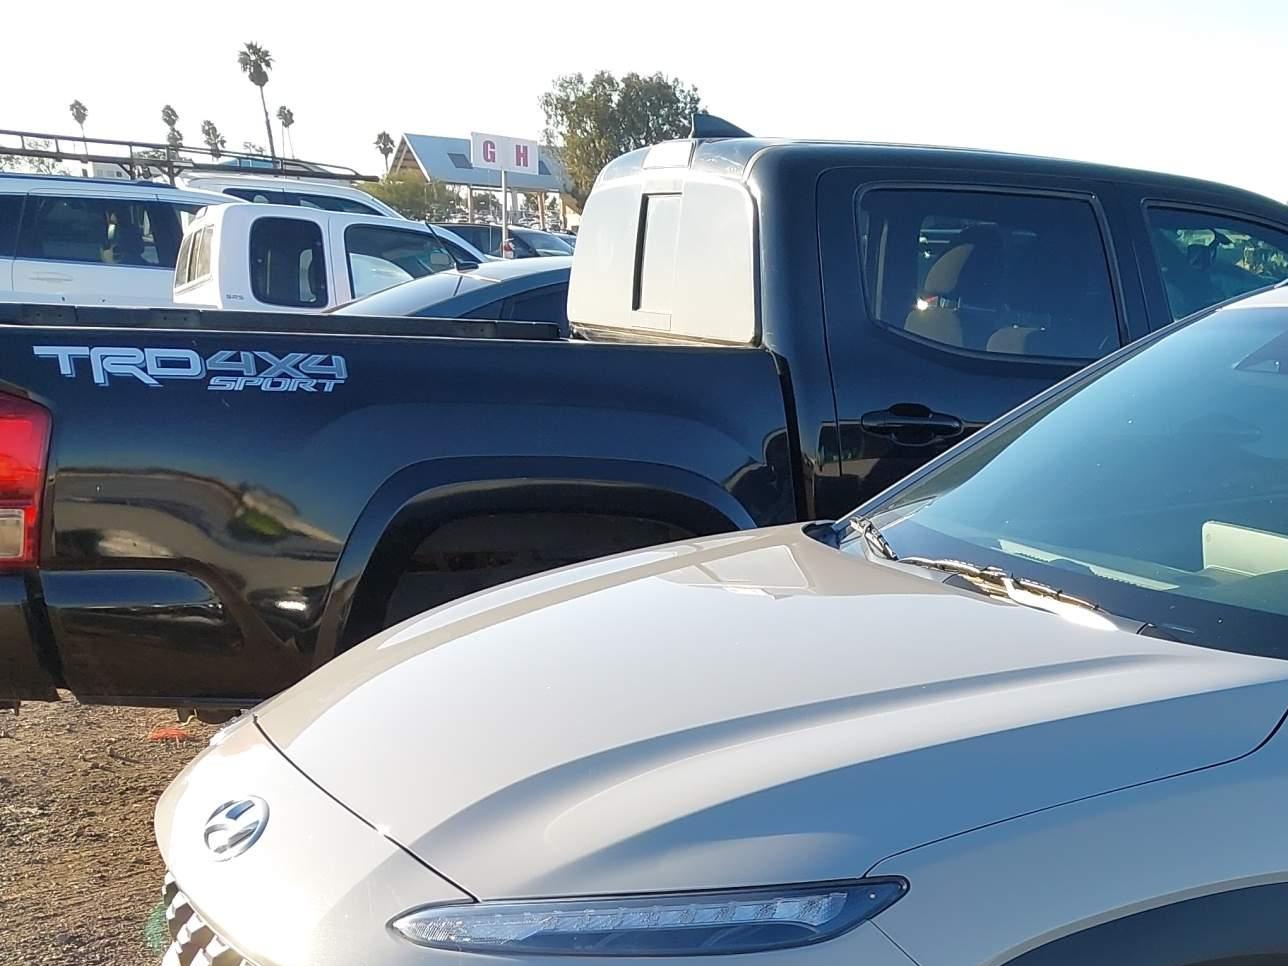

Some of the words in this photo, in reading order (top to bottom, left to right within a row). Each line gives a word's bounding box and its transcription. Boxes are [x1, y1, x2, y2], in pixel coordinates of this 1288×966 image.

[483, 140, 496, 163] G
[515, 144, 528, 167] H
[33, 345, 206, 387] TRD
[207, 375, 345, 392] SPORT
